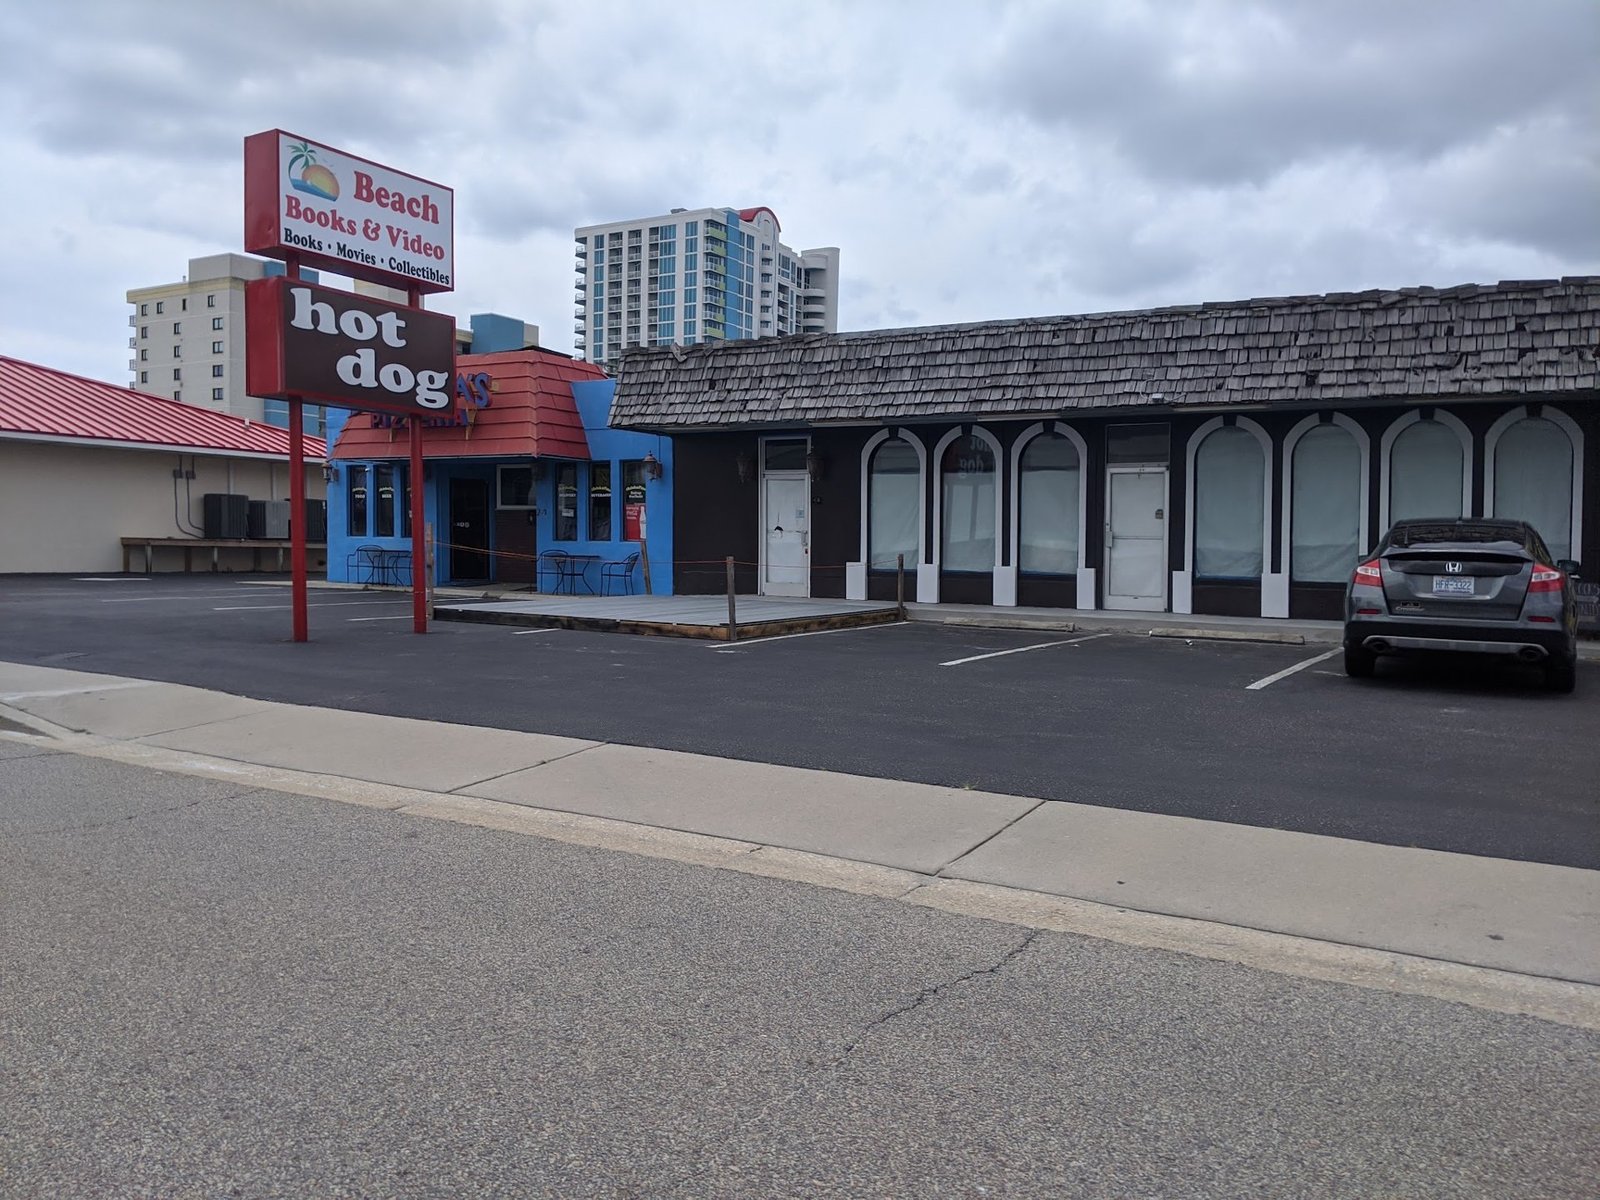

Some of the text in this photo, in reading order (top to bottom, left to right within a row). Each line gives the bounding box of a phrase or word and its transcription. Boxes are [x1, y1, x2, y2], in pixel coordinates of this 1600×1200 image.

[285, 194, 445, 261] Books & Video
[353, 170, 440, 225] Beach
[283, 227, 450, 285] Books Movies Collectibles
[289, 287, 408, 348] hot
[336, 348, 450, 409] dog
